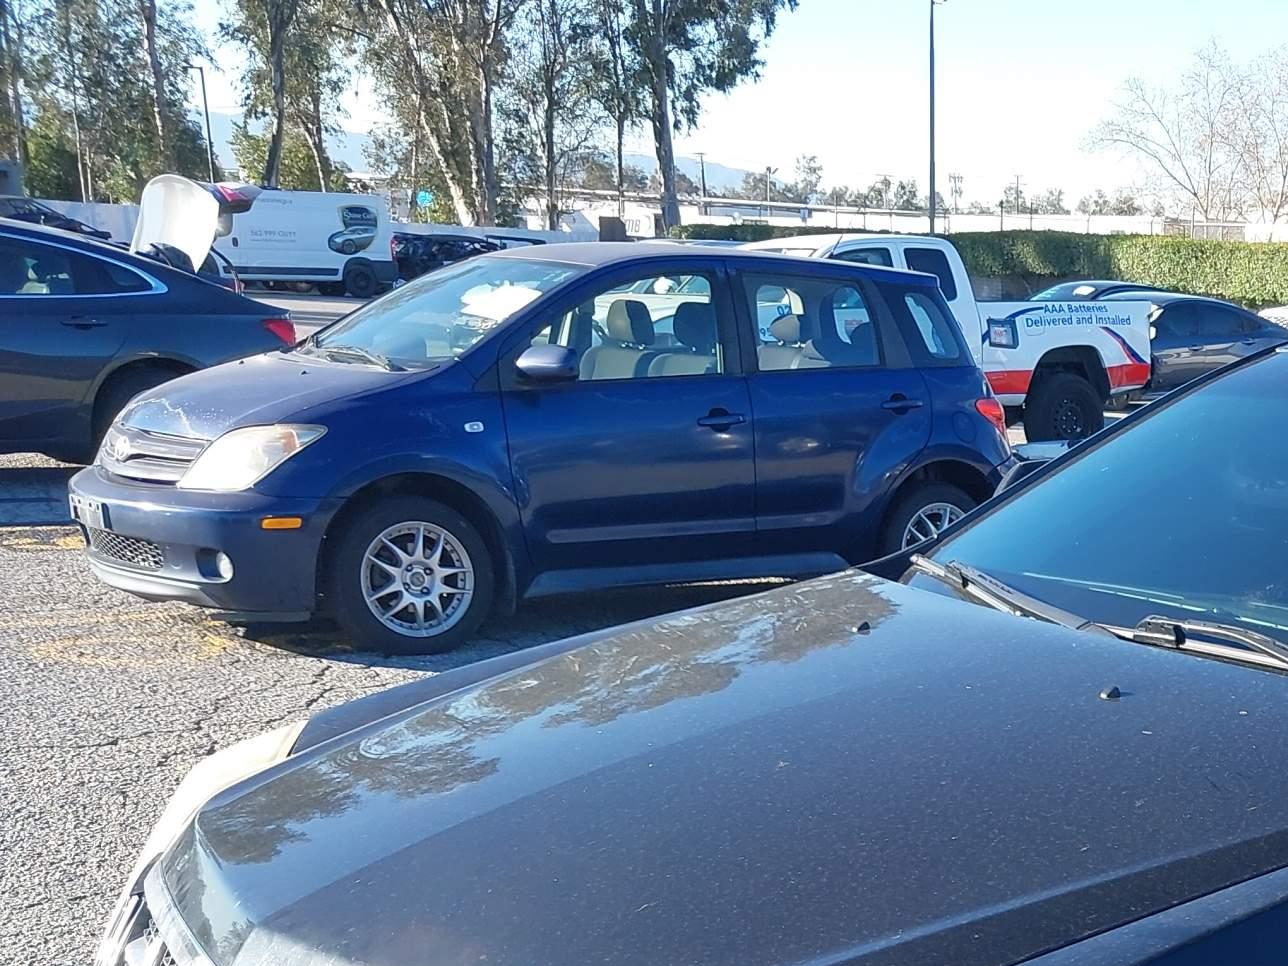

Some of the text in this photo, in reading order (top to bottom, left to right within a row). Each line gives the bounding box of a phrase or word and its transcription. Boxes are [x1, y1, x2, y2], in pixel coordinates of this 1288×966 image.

[1043, 303, 1109, 313] AAA Batteries
[1025, 315, 1131, 328] Delivered and Installed
